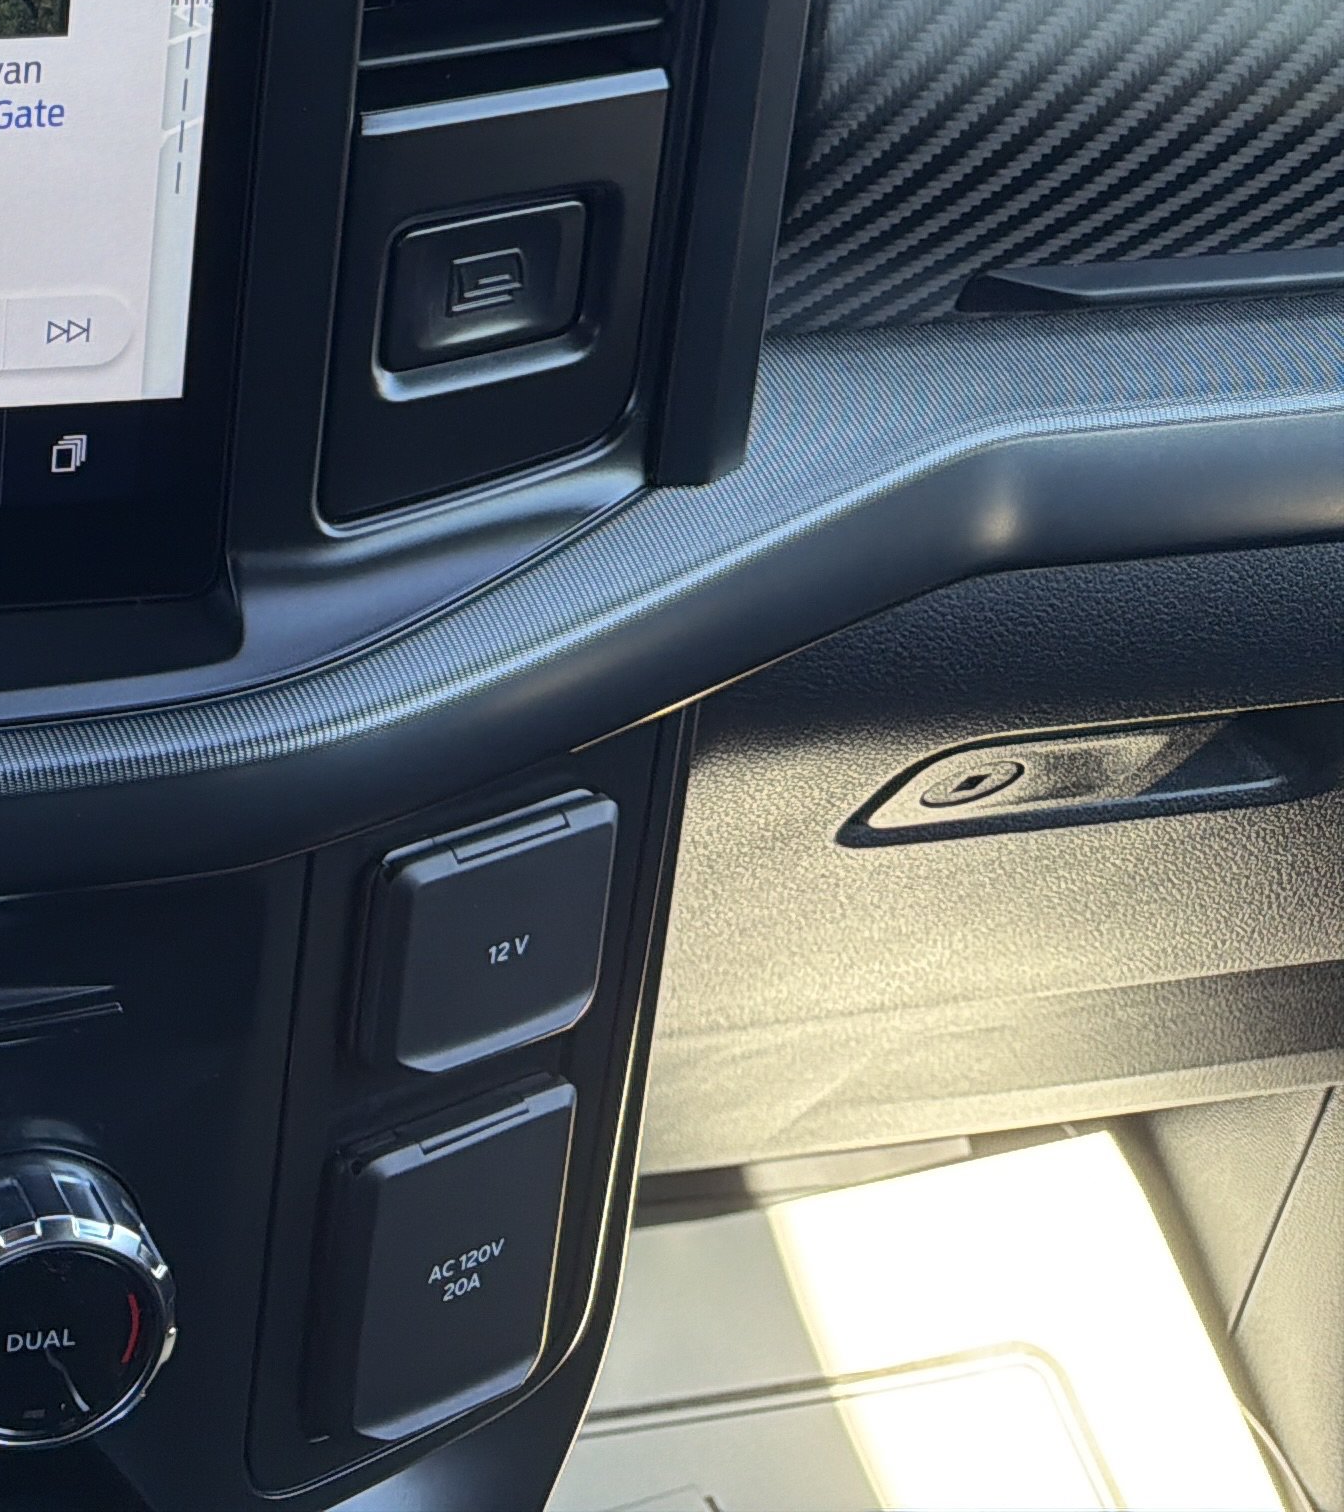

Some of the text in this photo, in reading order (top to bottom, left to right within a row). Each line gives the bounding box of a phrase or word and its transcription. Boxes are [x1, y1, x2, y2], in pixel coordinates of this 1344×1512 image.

[487, 933, 530, 965] 12 V
[427, 1238, 505, 1284] AC 120V
[442, 1272, 481, 1303] 20A
[5, 1327, 77, 1352] DUAL
